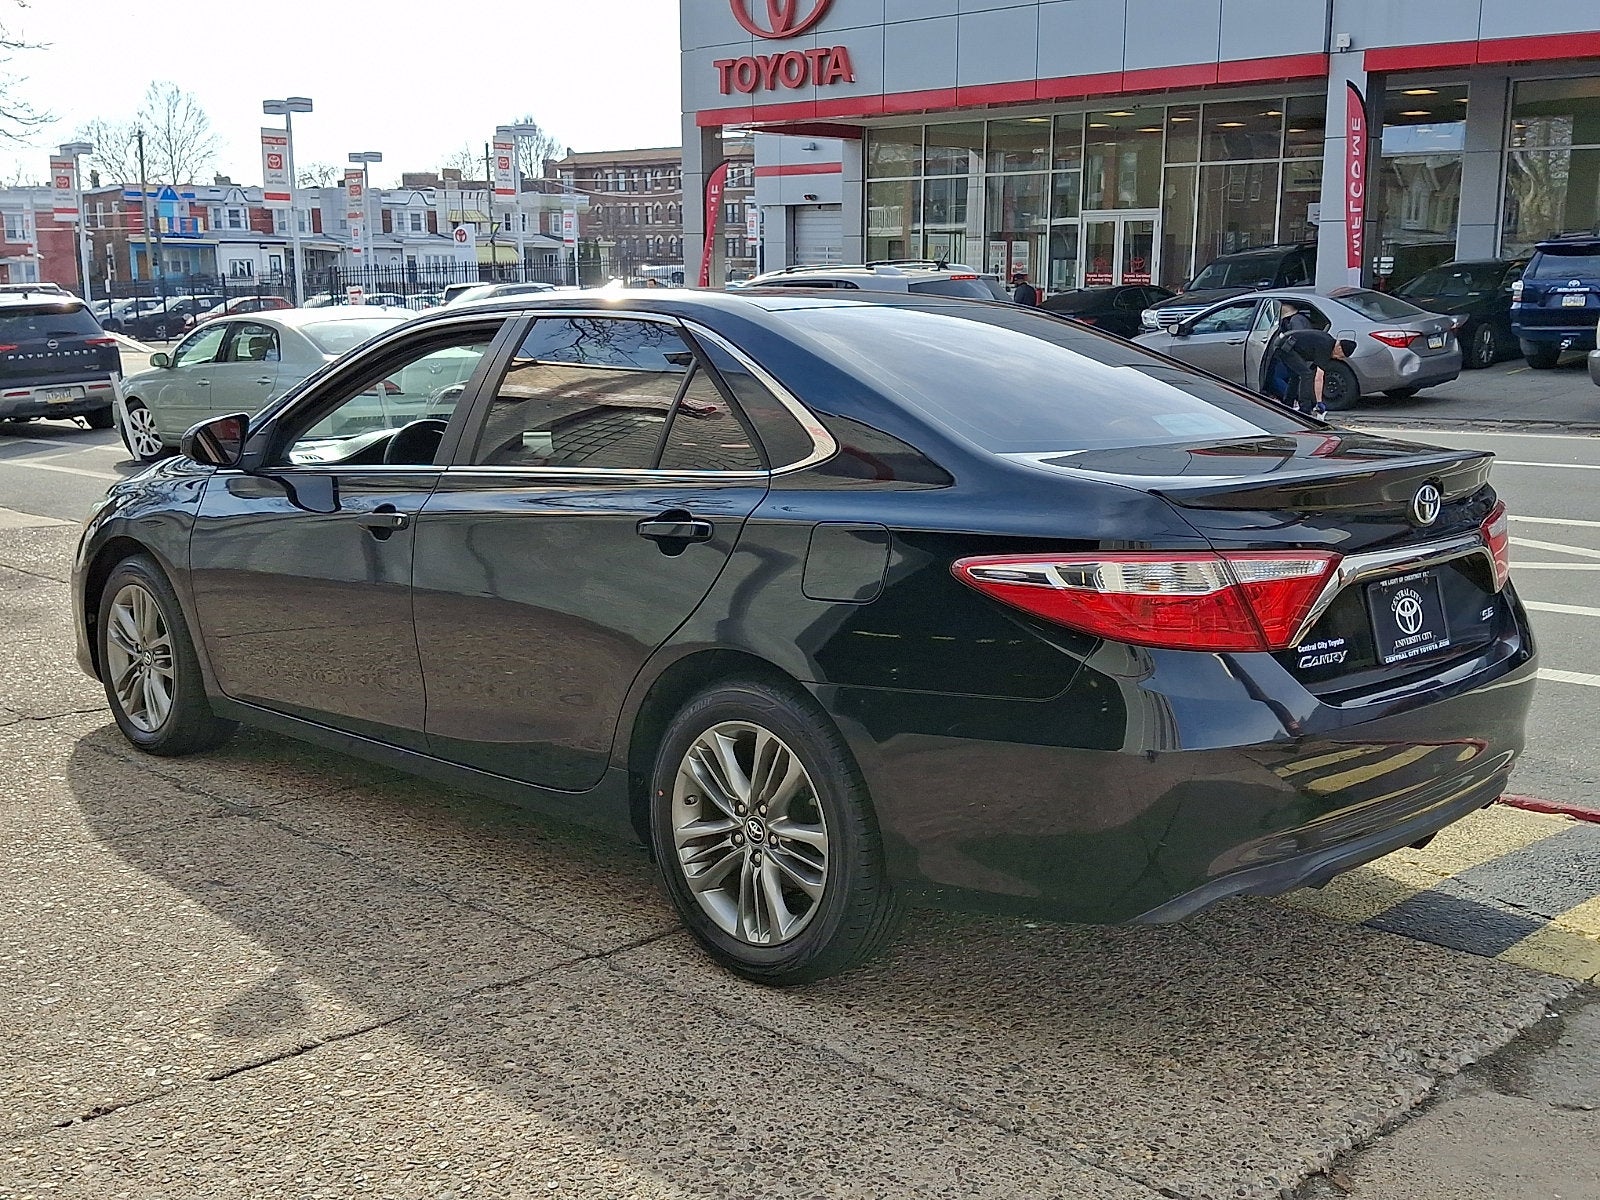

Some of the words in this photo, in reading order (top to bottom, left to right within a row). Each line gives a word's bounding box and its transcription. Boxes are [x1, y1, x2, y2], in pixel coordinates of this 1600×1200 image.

[713, 46, 855, 95] TOYOTA
[7, 348, 97, 361] PATHFINDER
[1391, 587, 1410, 612] CENTRAL
[1409, 589, 1424, 605] CITY
[1481, 606, 1494, 620] SE
[1297, 643, 1317, 653] Central
[1317, 641, 1328, 650] City
[1327, 638, 1345, 648] Toyota
[1395, 634, 1422, 648] UNIVERSITY
[1421, 630, 1434, 641] CITY
[1385, 652, 1409, 664] CENTRAL
[1408, 649, 1420, 658] CITY
[1420, 643, 1439, 654] TOYOTA
